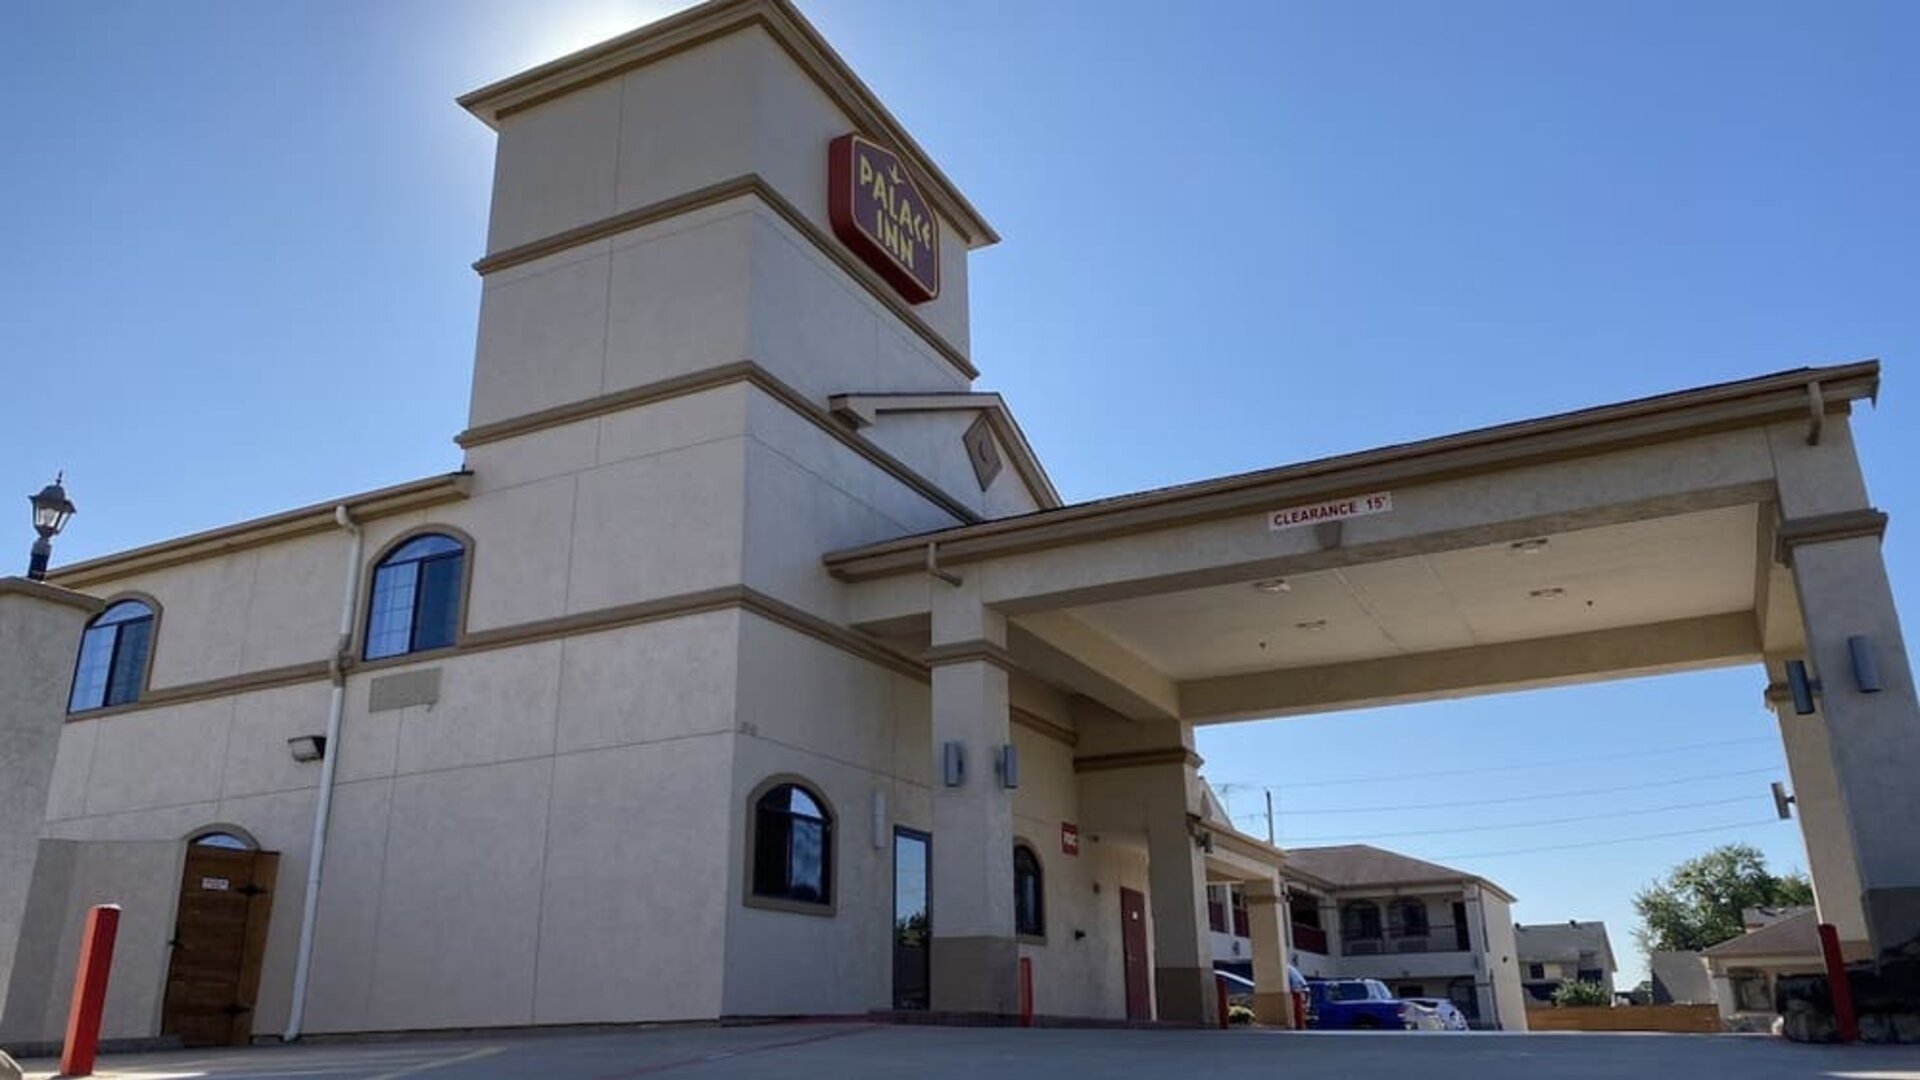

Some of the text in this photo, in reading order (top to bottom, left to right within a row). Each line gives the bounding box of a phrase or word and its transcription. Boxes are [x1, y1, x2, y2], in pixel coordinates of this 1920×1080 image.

[860, 155, 930, 250] PALACE
[877, 209, 914, 270] INN
[1274, 502, 1357, 526] CLEARANCE
